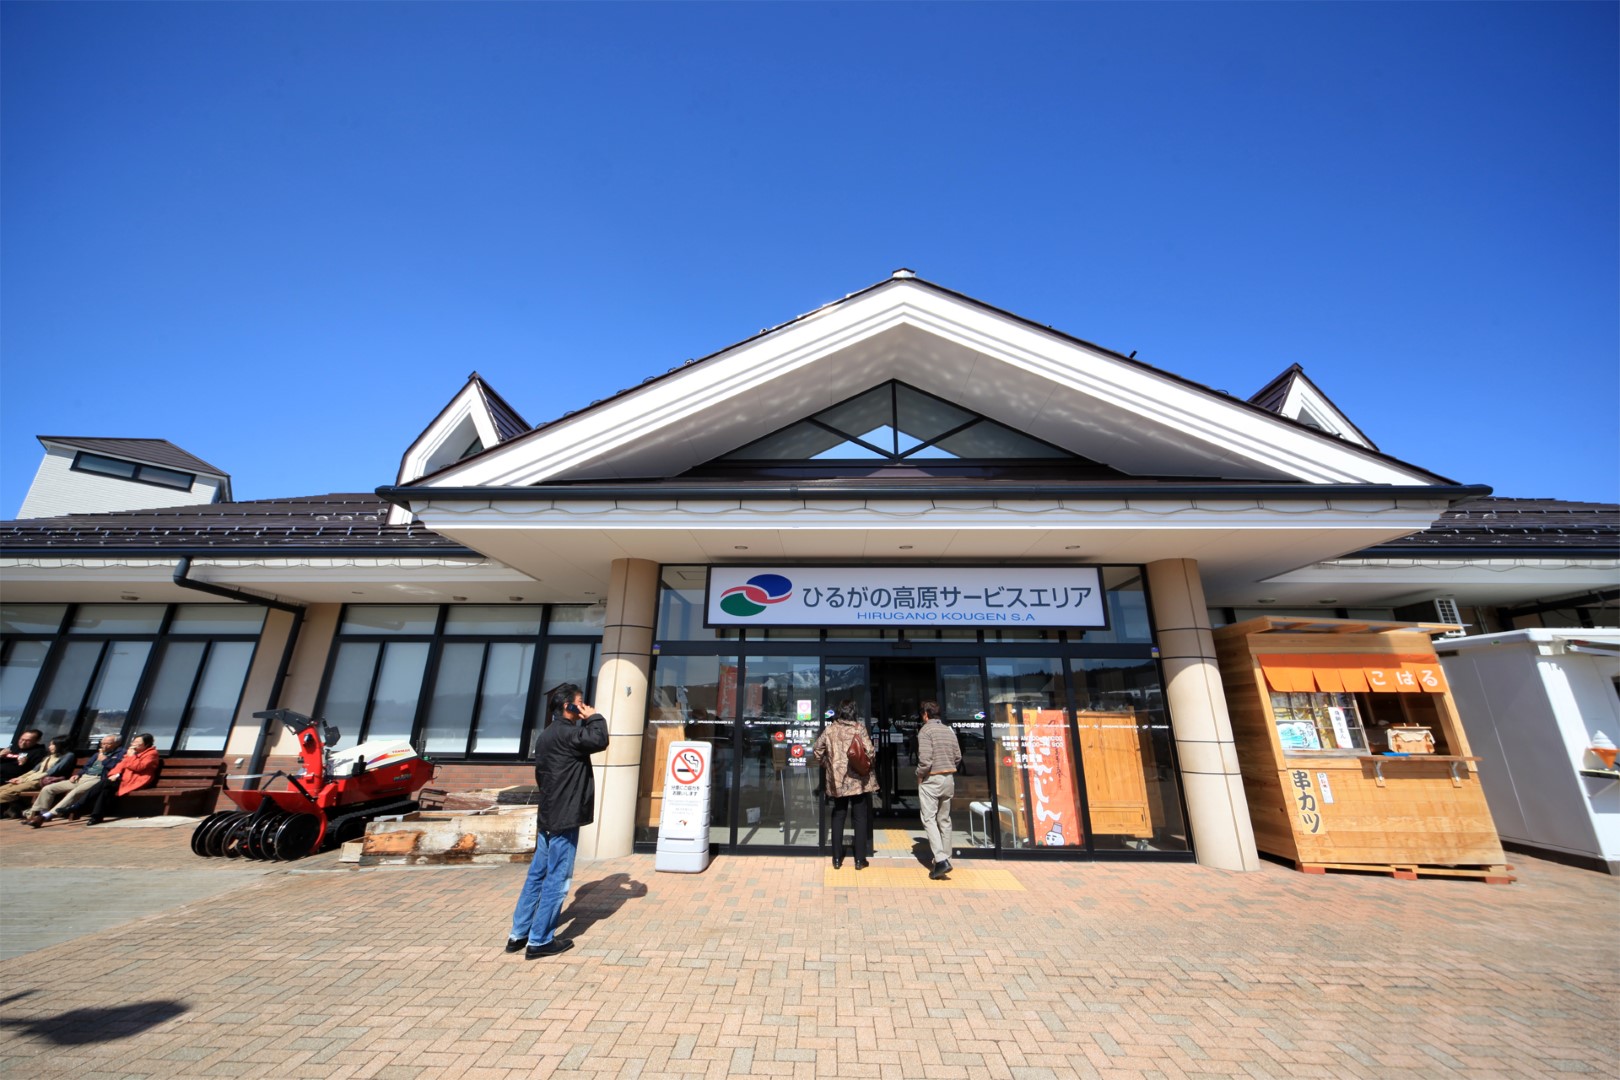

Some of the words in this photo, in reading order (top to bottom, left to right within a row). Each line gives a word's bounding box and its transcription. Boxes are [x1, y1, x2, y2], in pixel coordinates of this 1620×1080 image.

[802, 586, 1092, 610] ひるがの高原サービスエリア
[857, 612, 937, 621] HIRUGANO
[941, 612, 1006, 621] KOUGEN
[1011, 613, 1035, 621] S.A
[1371, 670, 1438, 687] こはる
[1292, 770, 1320, 834] 串カツ
